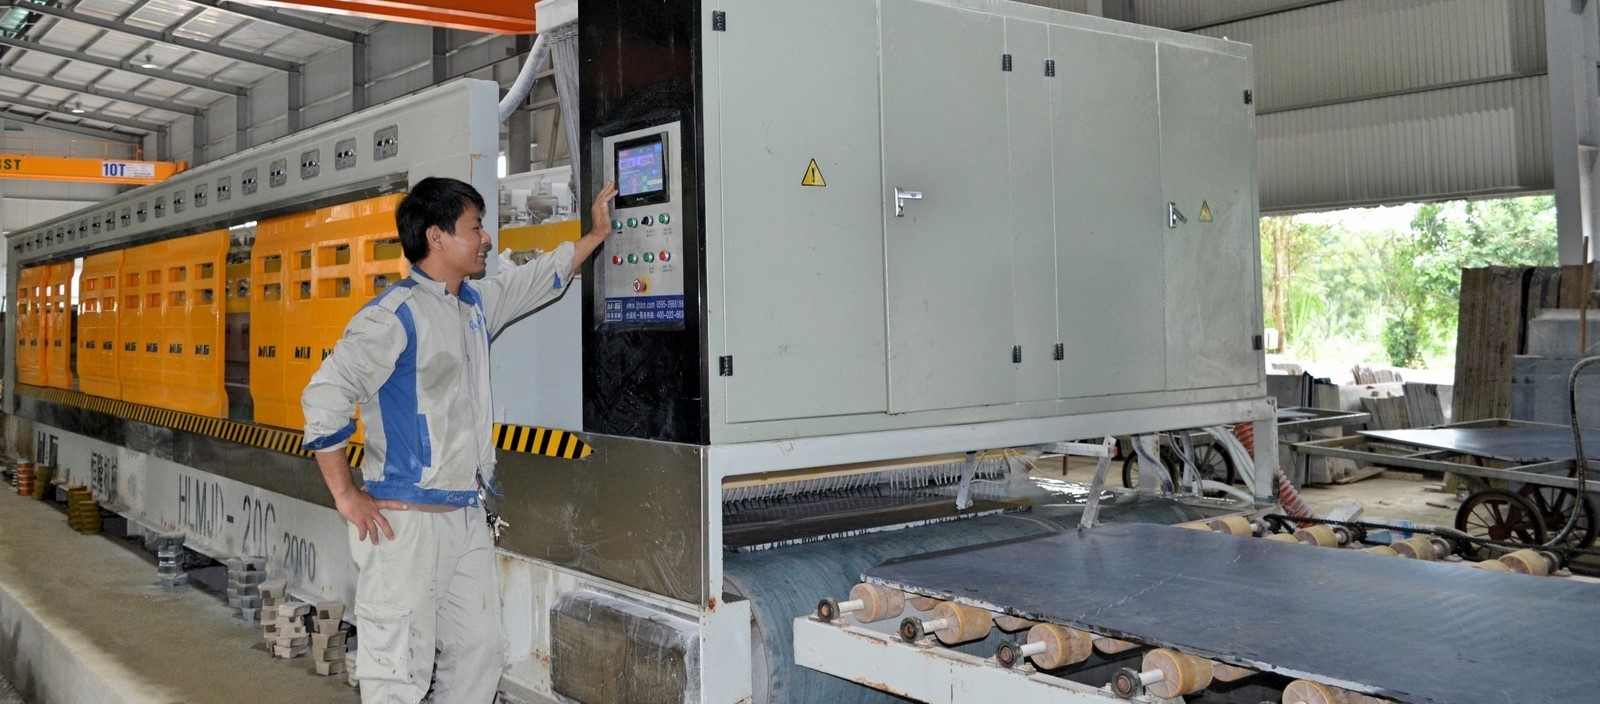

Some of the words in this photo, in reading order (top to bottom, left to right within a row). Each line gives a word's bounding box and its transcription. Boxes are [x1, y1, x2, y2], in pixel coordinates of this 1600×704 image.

[0, 159, 21, 170] ST
[103, 163, 126, 177] 10T
[283, 531, 316, 582] 2000
